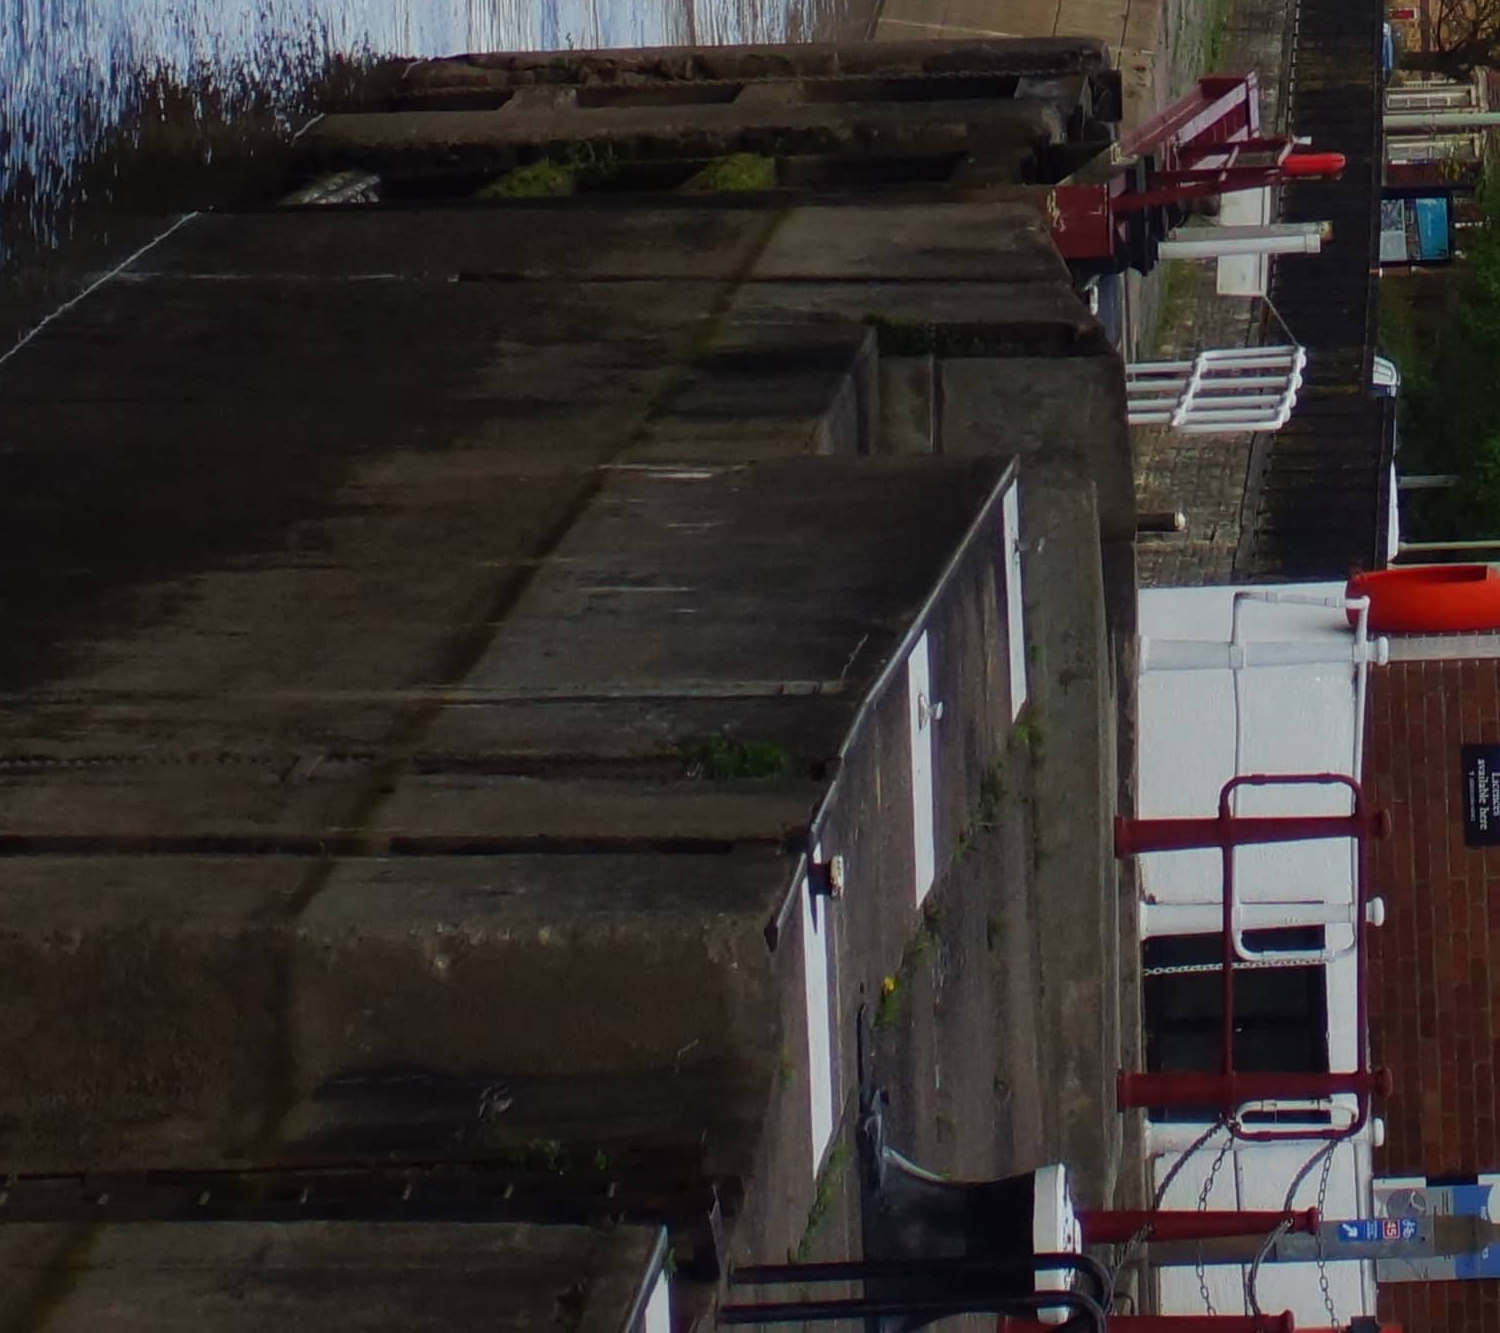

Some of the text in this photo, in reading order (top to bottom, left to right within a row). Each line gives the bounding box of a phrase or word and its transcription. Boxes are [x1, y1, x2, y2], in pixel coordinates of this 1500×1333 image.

[1477, 758, 1490, 831] available here
[1386, 1221, 1396, 1236] 45
